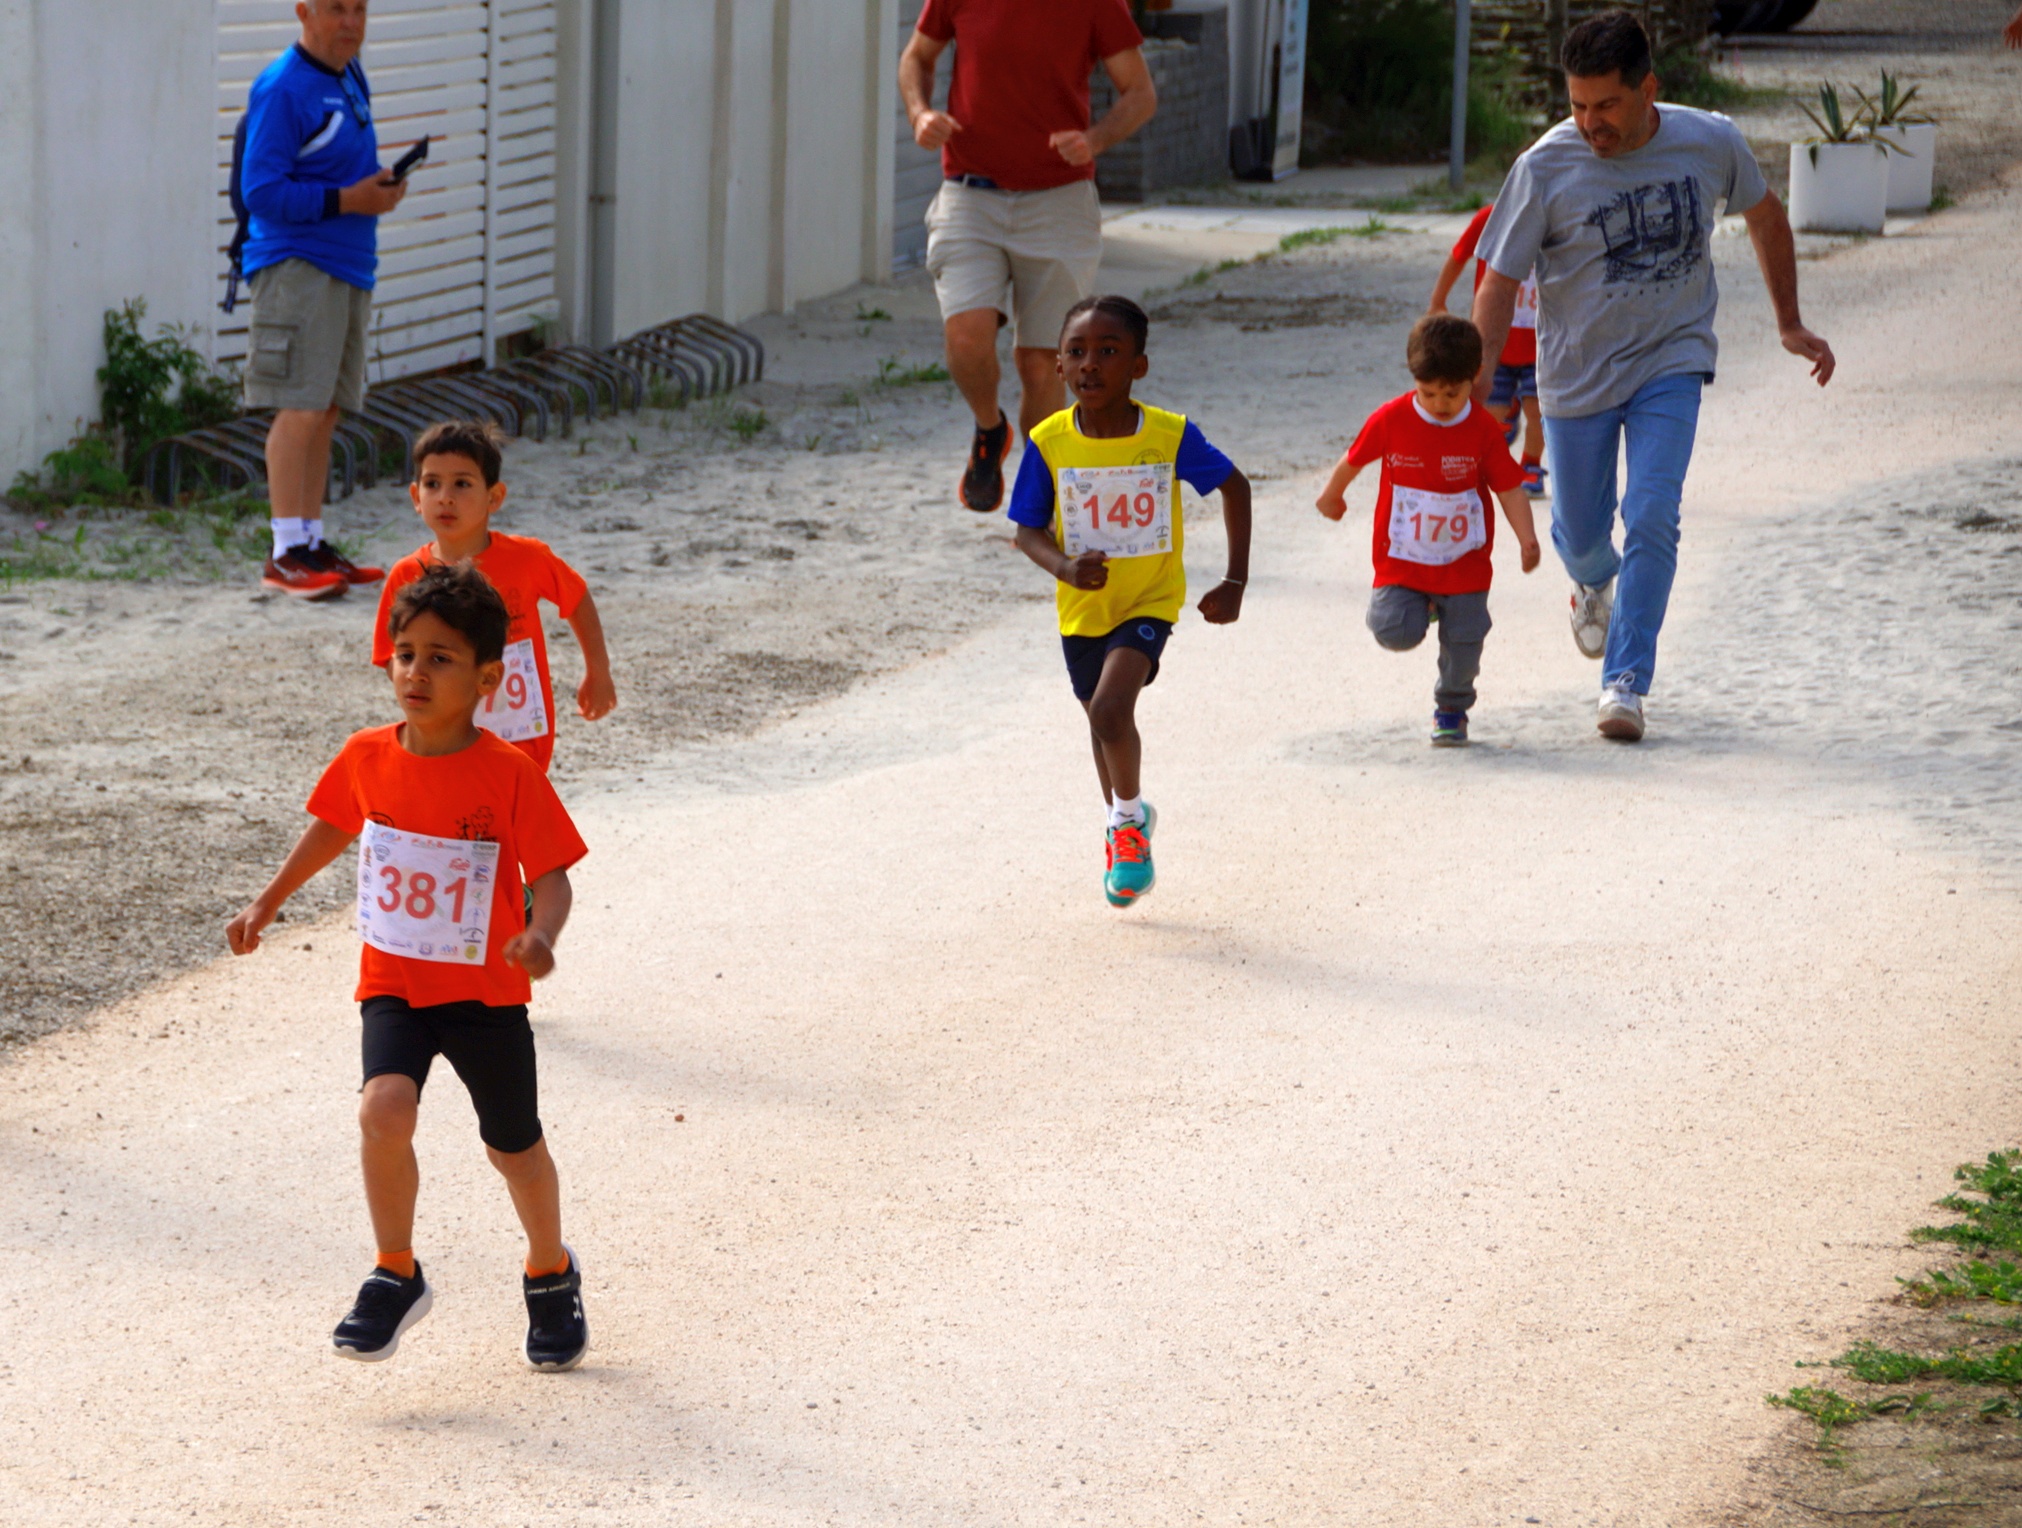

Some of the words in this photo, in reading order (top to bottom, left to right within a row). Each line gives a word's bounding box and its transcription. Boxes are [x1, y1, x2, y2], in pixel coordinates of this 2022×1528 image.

[1082, 491, 1155, 530] 149
[1409, 511, 1469, 544] 179
[376, 865, 468, 924] 381
